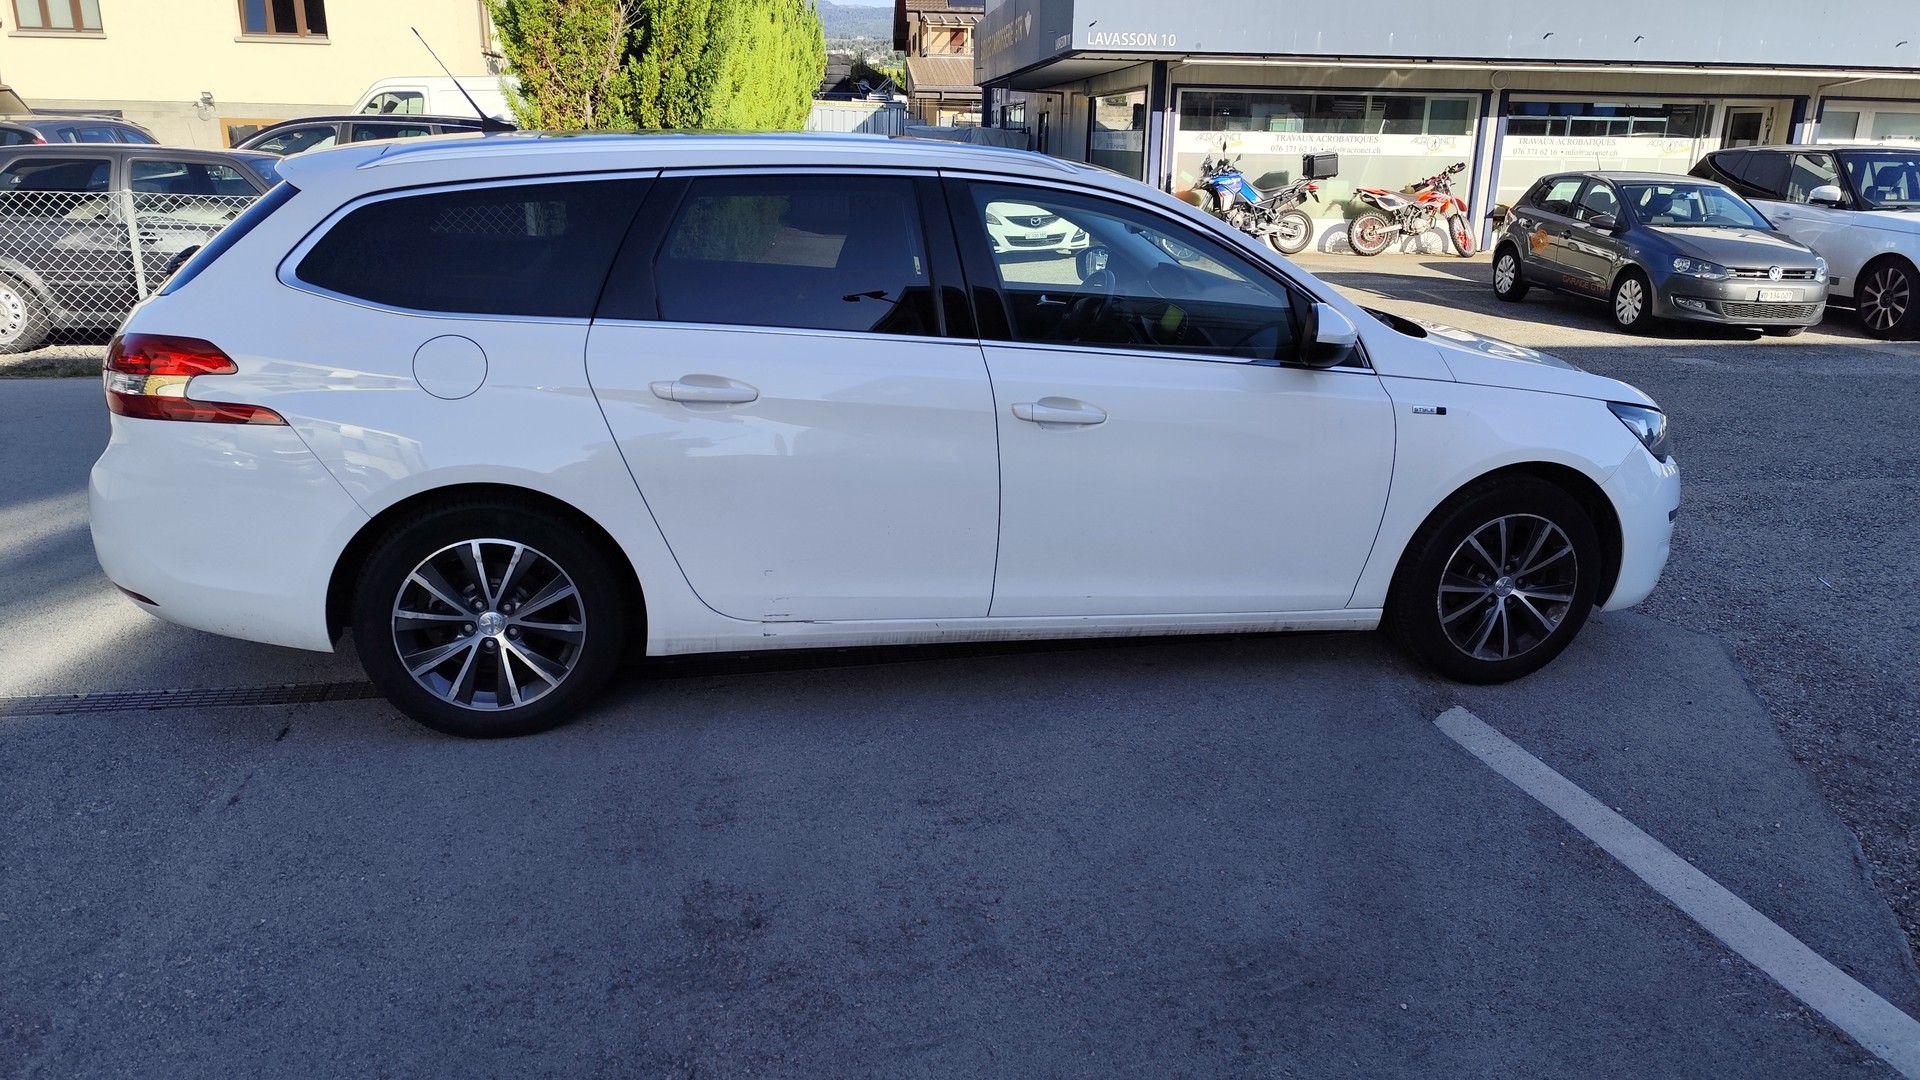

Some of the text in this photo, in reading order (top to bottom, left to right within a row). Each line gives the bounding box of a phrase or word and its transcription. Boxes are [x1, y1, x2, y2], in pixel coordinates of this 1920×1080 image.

[1087, 31, 1177, 47] LAVASSON 10
[1275, 134, 1379, 144] TRAVAUX ACROBATIQUES
[1518, 137, 1617, 147] TRAVAUX ACROBATIQUES
[1270, 144, 1284, 153] 076
[1285, 145, 1297, 153] 371
[1298, 145, 1308, 153] 62
[1309, 145, 1318, 153] 16
[1512, 147, 1525, 155] 076
[1526, 148, 1538, 156] 371
[1539, 148, 1548, 156] 62
[1549, 148, 1558, 156] 16
[1562, 274, 1589, 289] GARAGE
